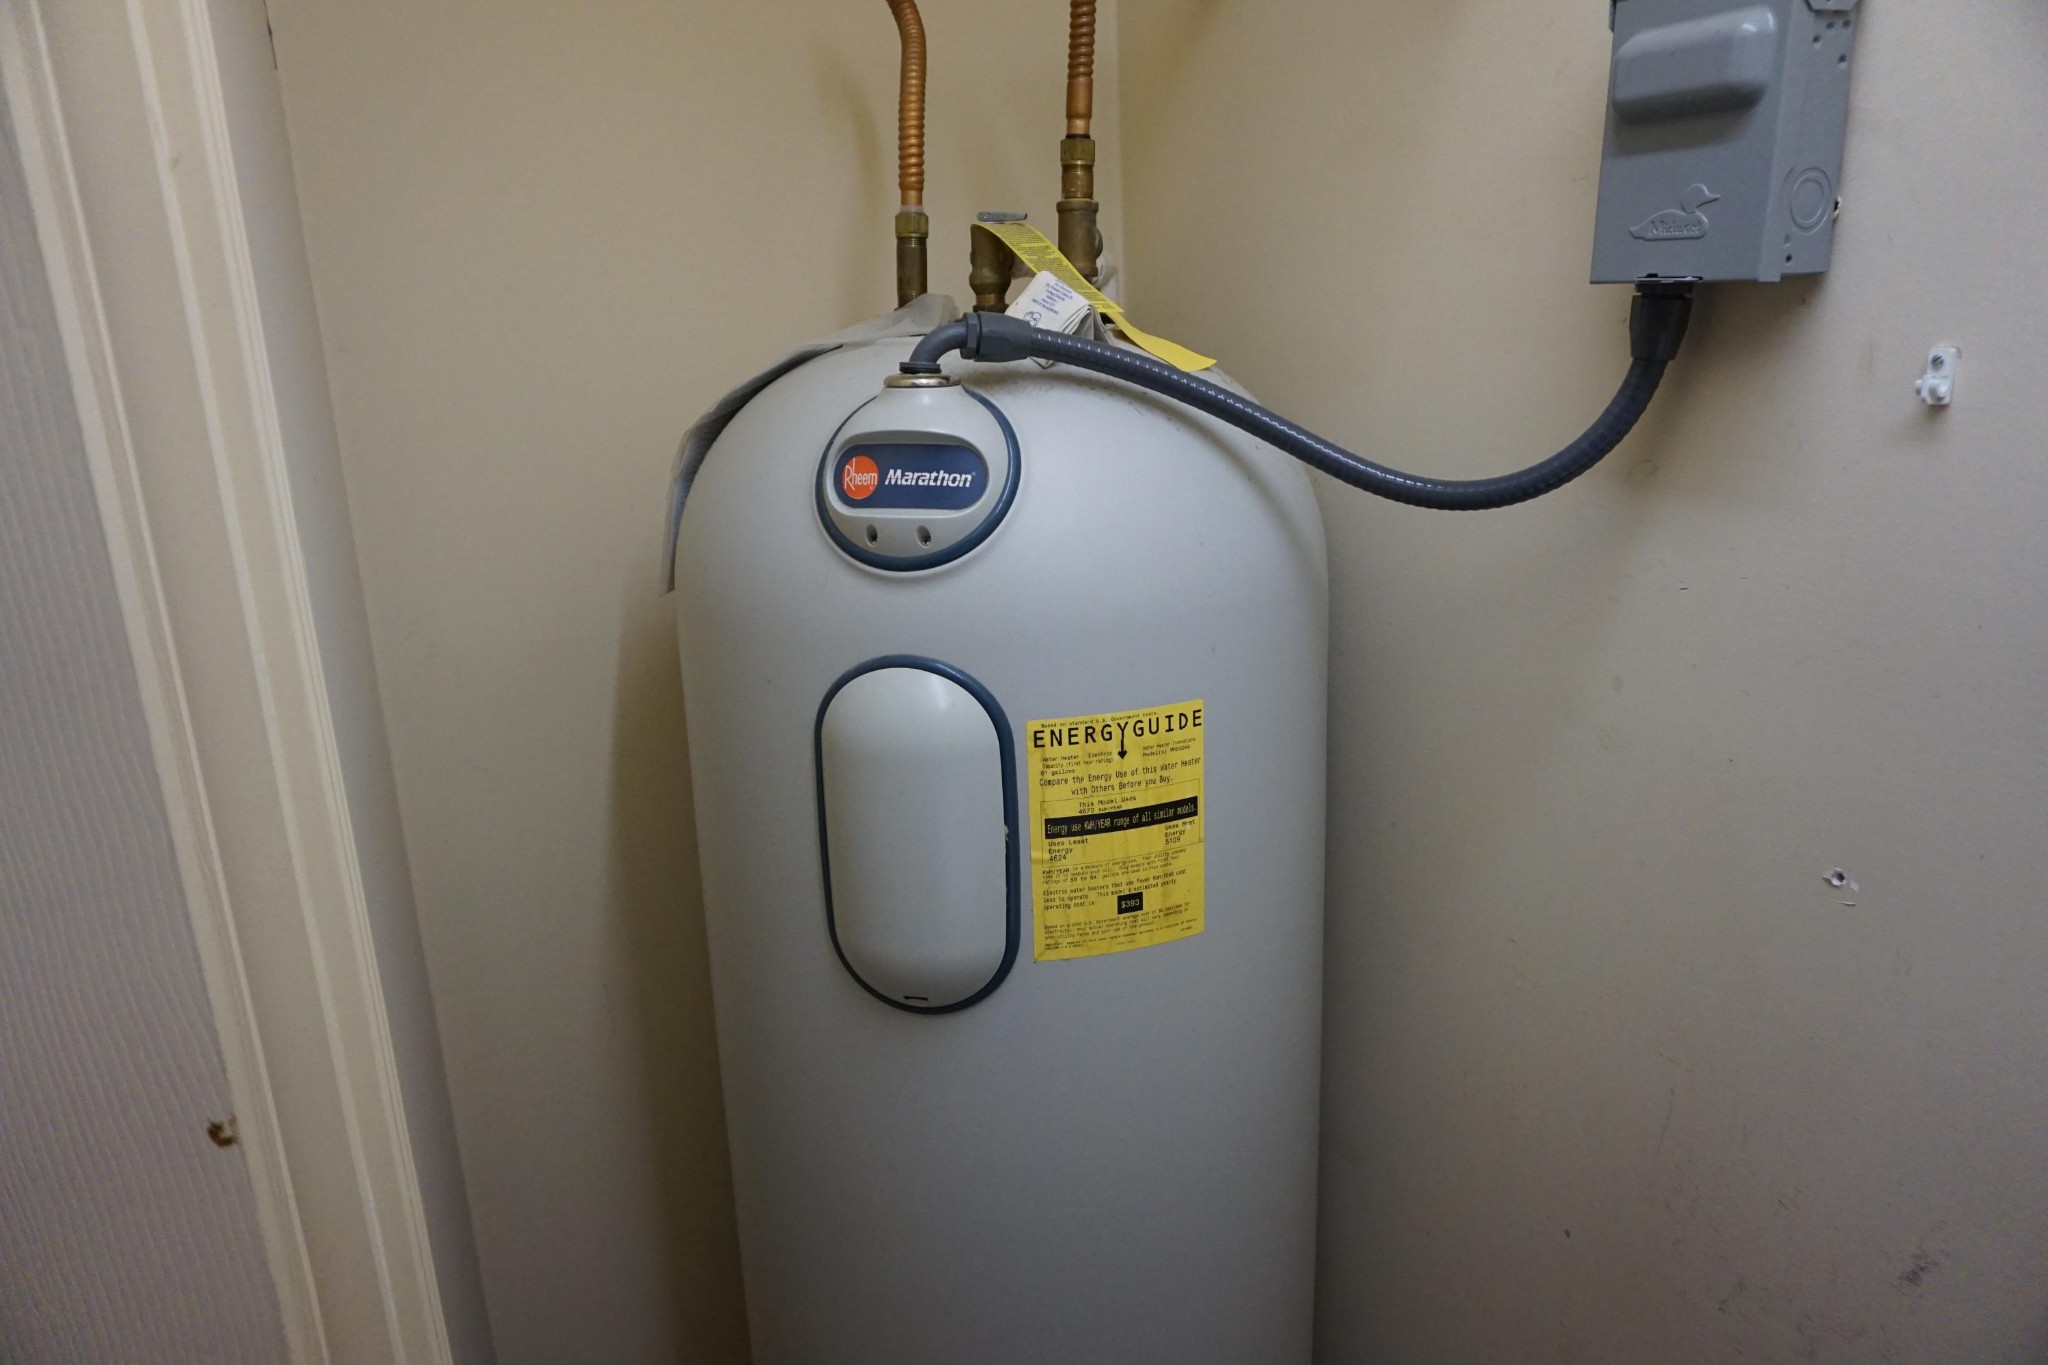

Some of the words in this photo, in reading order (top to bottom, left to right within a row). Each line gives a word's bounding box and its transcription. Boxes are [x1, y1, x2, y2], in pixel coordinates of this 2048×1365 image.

[844, 457, 878, 491] Rheem
[884, 468, 972, 488] Marathon
[1040, 776, 1069, 788] Compare
[1073, 775, 1084, 783] the
[1089, 772, 1112, 784] Energy
[1116, 770, 1127, 778] Use
[1131, 768, 1138, 776] of
[1143, 765, 1157, 774] this
[1160, 762, 1178, 771] Water
[1181, 757, 1201, 767] Heater
[1071, 787, 1087, 795] with
[1091, 783, 1115, 793] Others
[1119, 779, 1141, 789] Before
[1145, 778, 1156, 787] you
[1048, 823, 1069, 835] Energy
[1114, 816, 1129, 827] range
[1133, 814, 1140, 823] of
[1141, 811, 1151, 822] all
[1154, 807, 1175, 819] similar
[1165, 829, 1185, 838] Energy
[1165, 836, 1181, 845] 5109
[1049, 846, 1073, 856] Energy
[1049, 854, 1067, 862] 4624
[1120, 899, 1139, 908] $393
